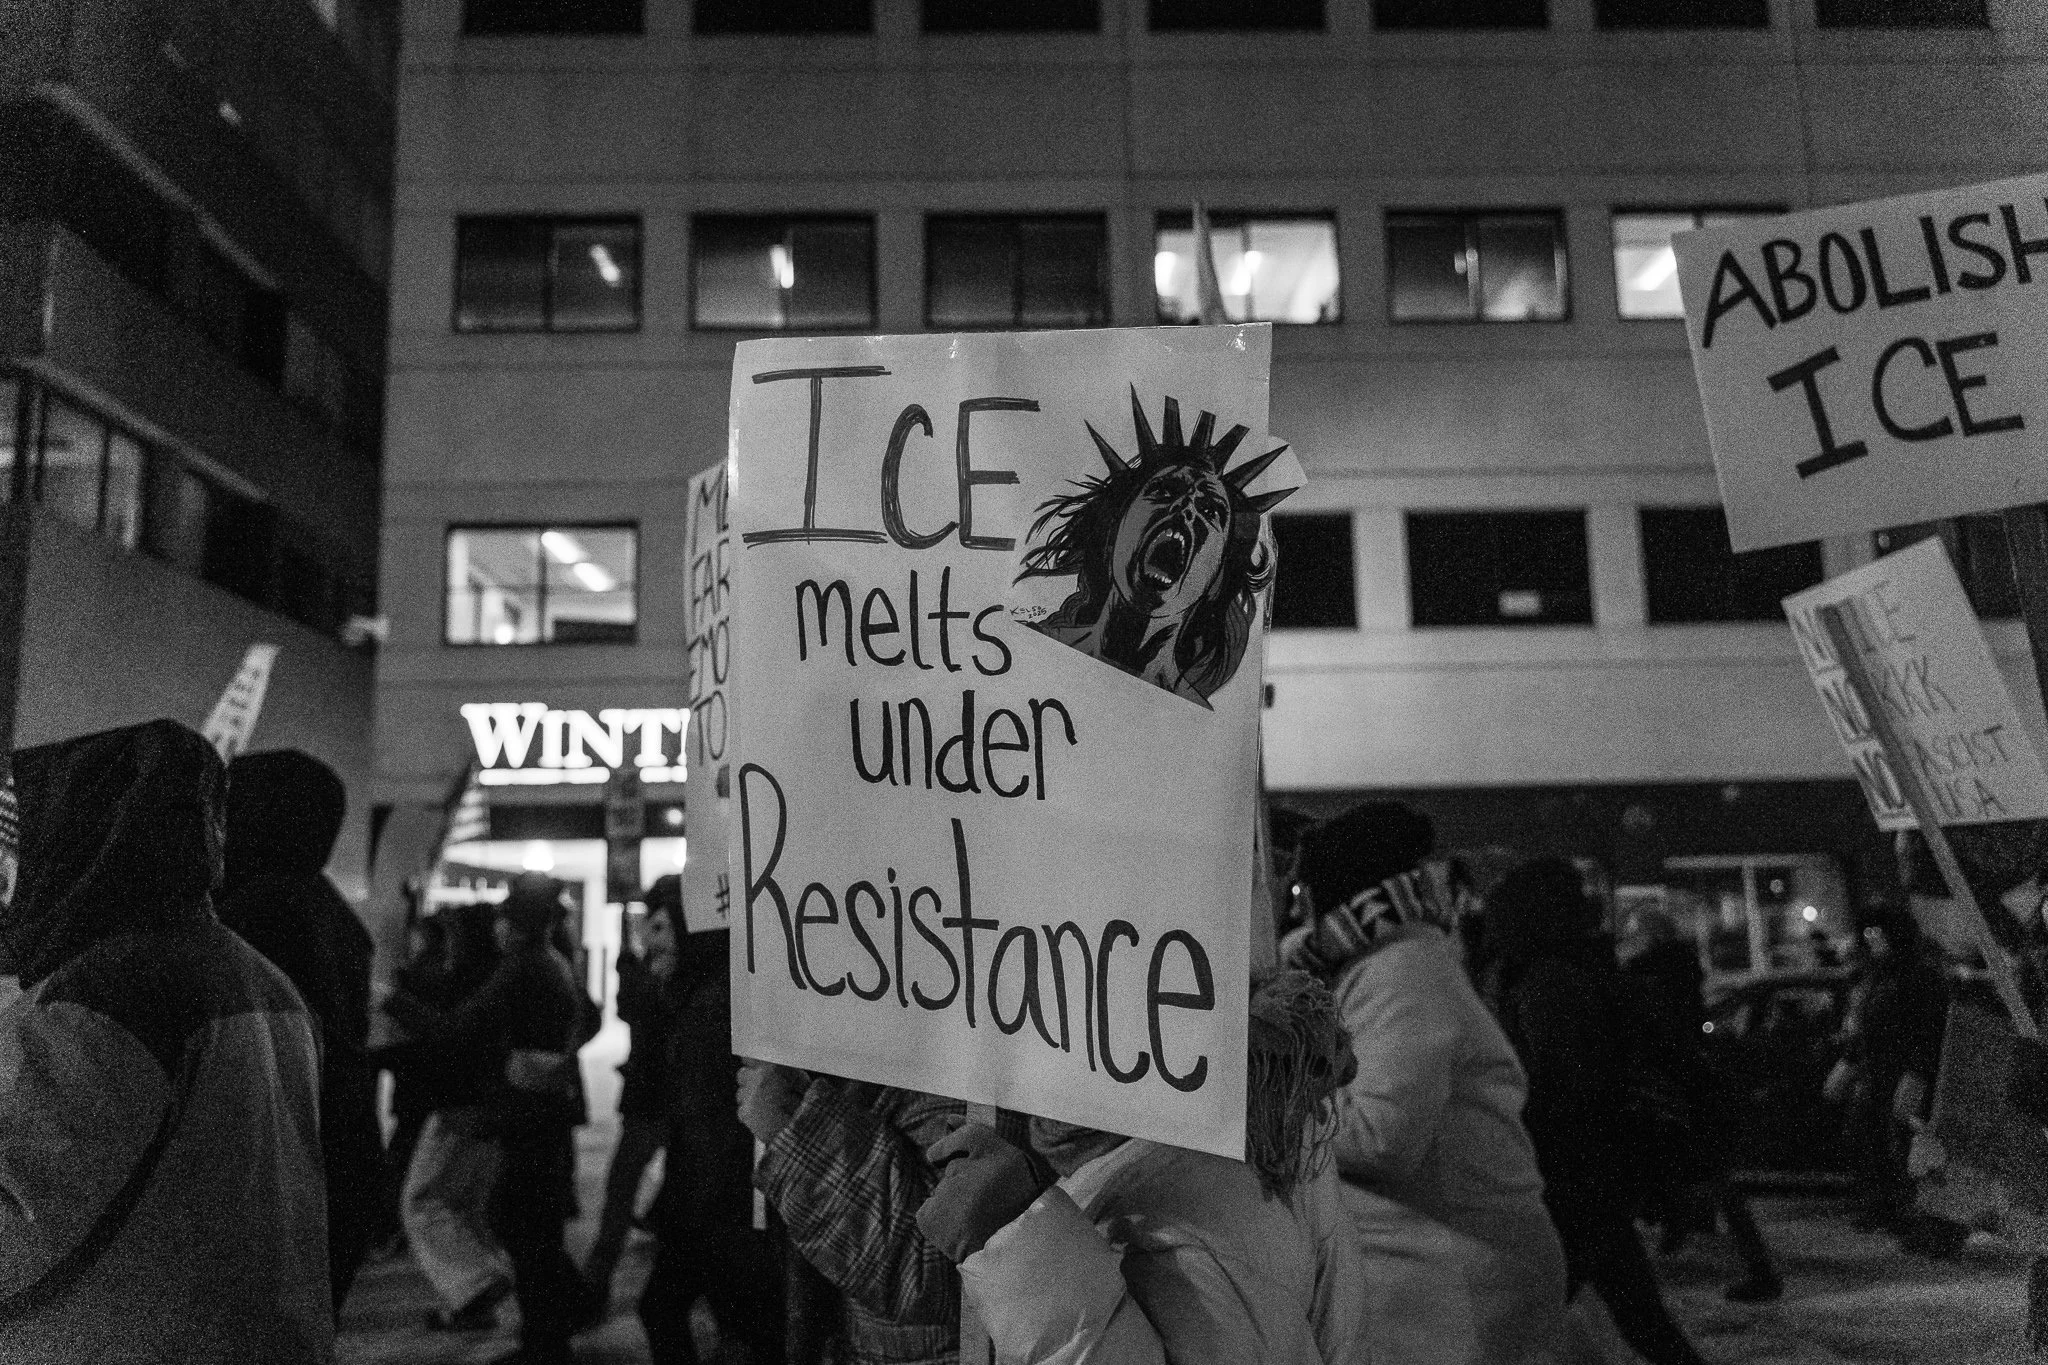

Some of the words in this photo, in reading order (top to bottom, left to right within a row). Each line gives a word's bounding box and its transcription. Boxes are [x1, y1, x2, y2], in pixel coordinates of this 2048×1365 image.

[1702, 198, 2048, 349] ABOLISH
[742, 366, 1040, 551] ICE
[1766, 331, 2025, 479] ICE
[795, 566, 1012, 676] melts
[460, 702, 690, 768] WINT
[850, 690, 1077, 801] under
[738, 763, 1216, 1092] Resistance
